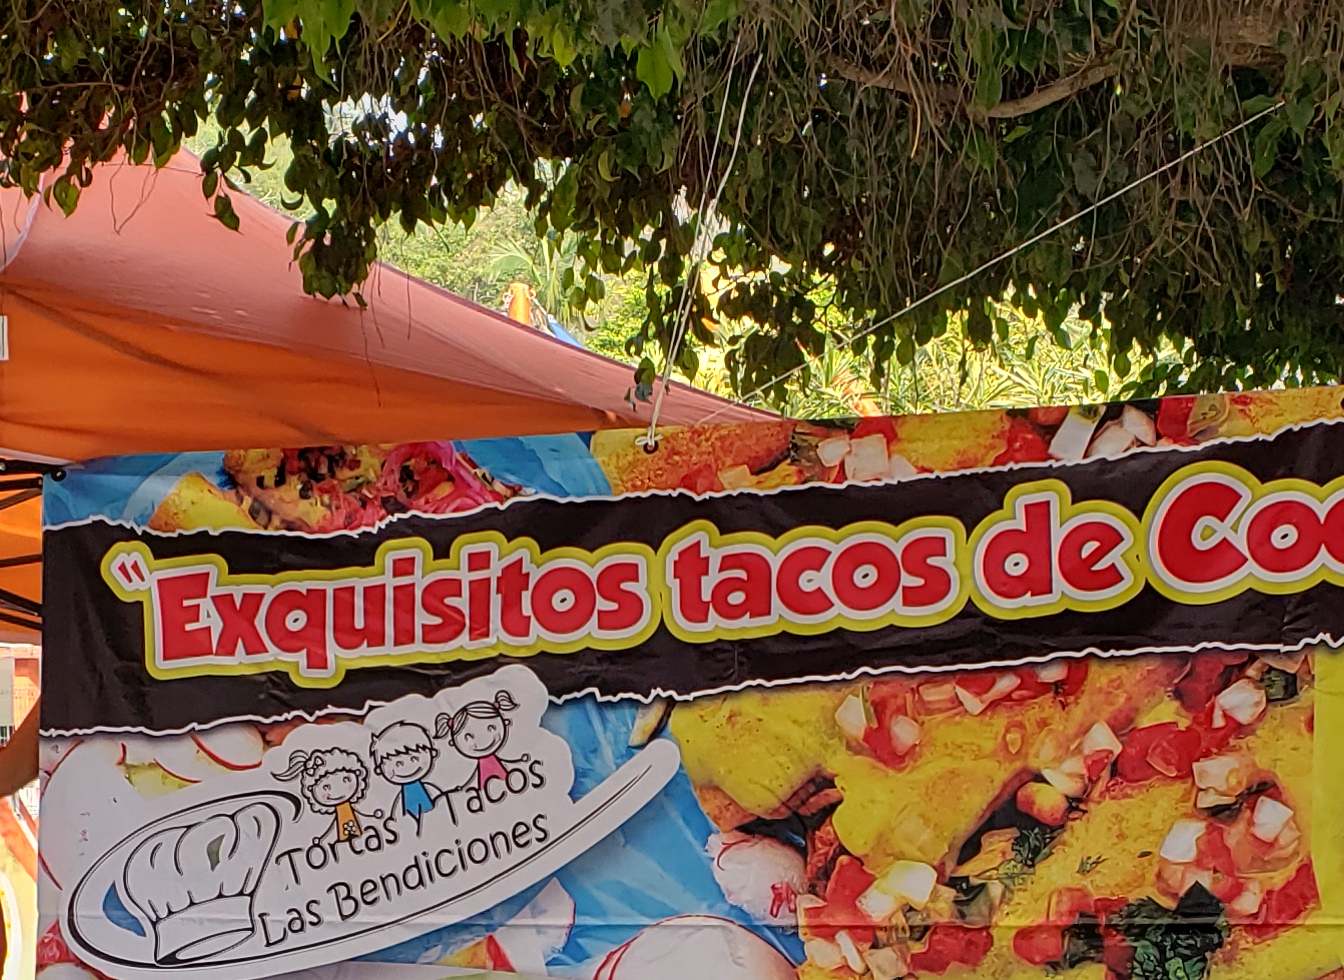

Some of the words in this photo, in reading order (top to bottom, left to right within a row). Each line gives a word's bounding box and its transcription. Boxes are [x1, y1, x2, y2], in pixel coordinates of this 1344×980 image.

[667, 525, 955, 632] tacos
[976, 497, 1129, 602] de
[258, 894, 323, 949] Las
[326, 812, 550, 920] Bendiciones
[275, 816, 399, 886] Tortas
[407, 801, 427, 837] y
[442, 757, 546, 827] Tacos
